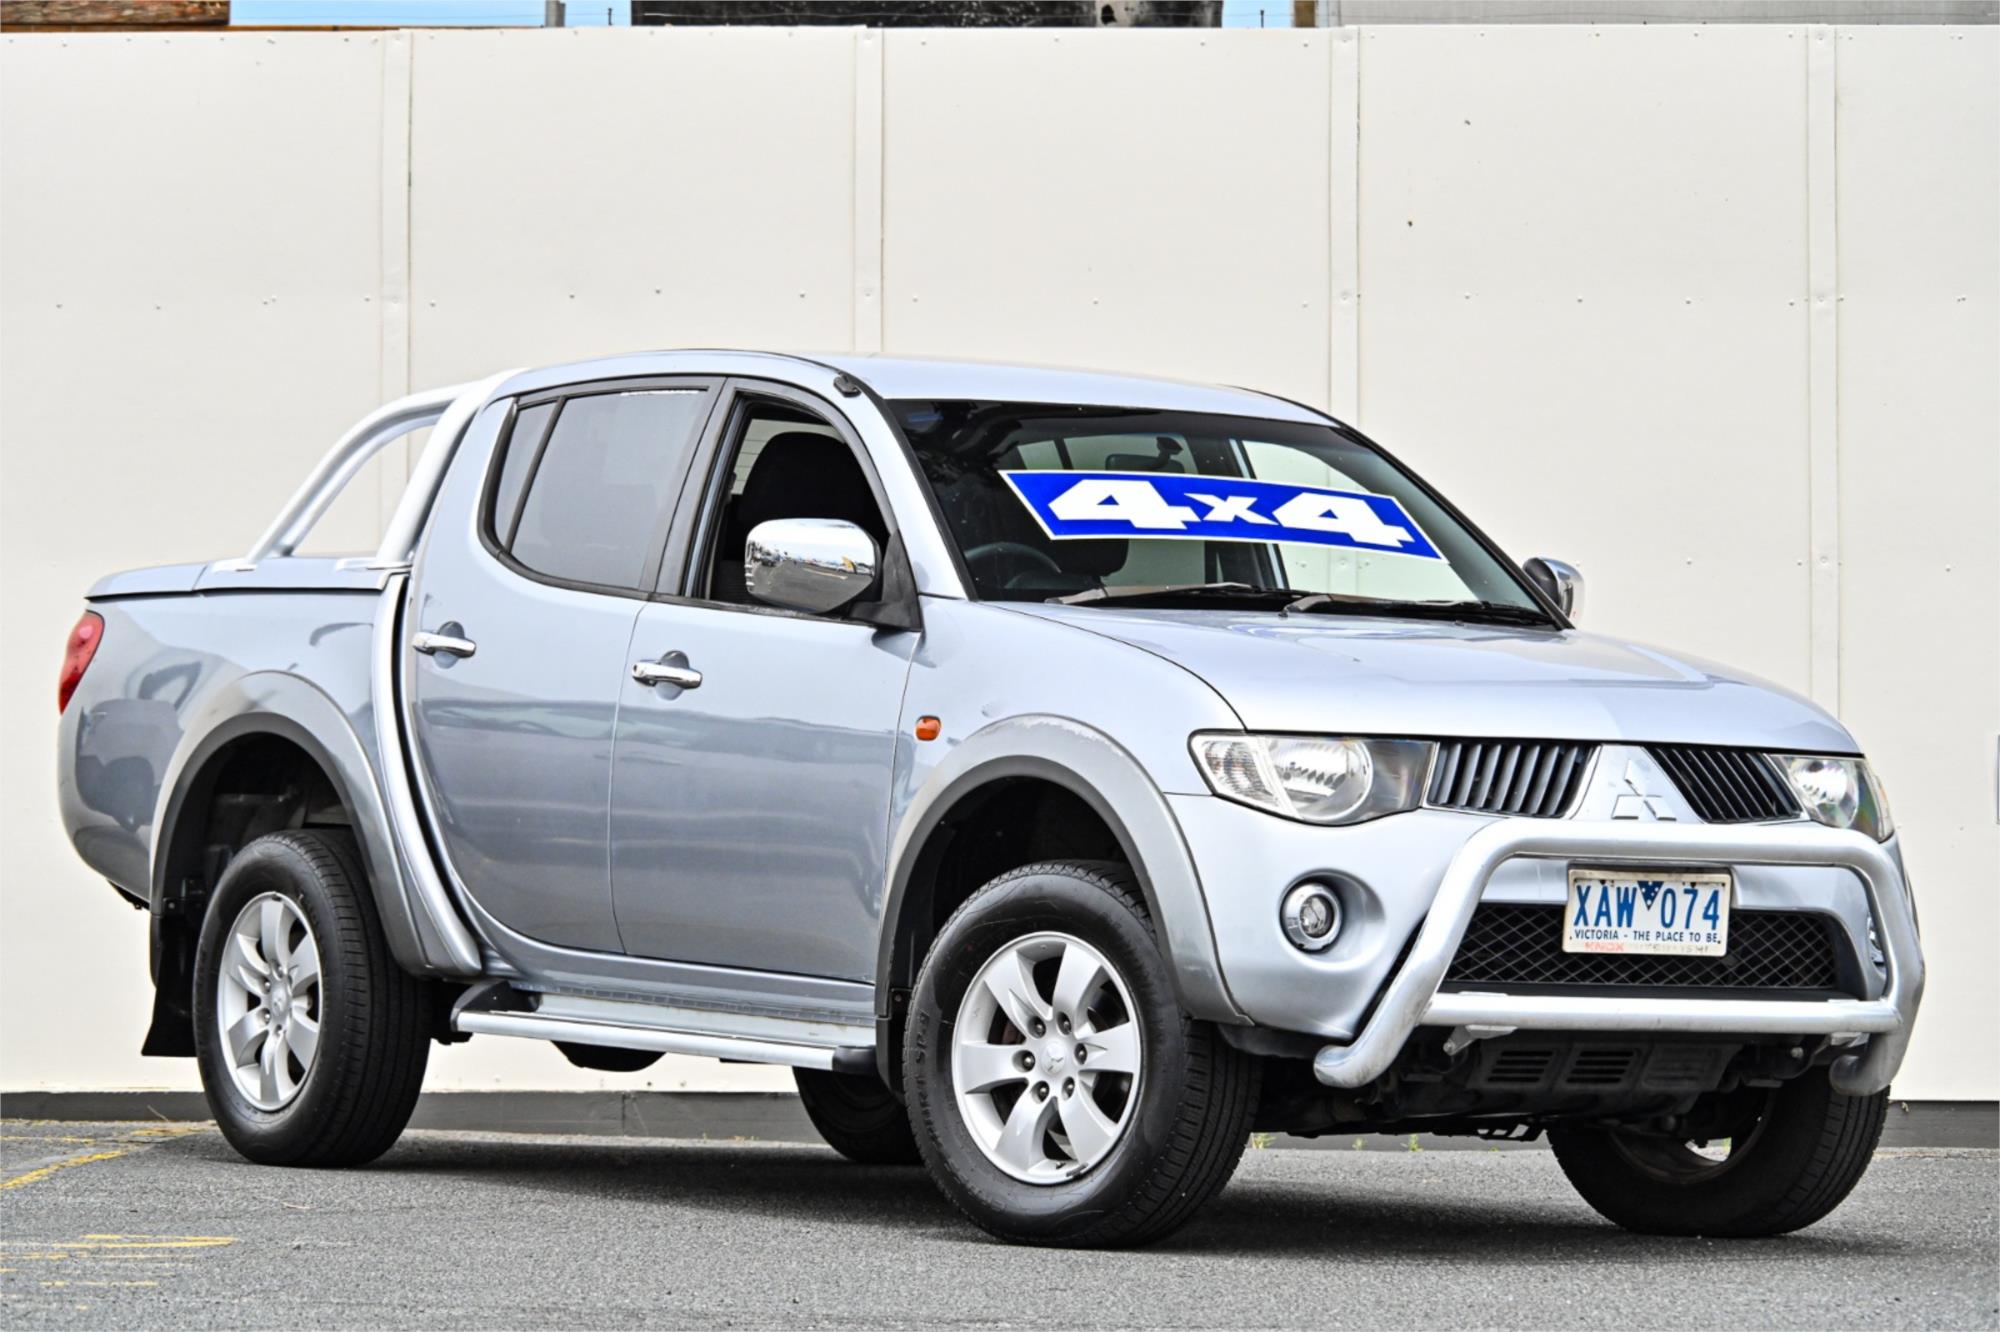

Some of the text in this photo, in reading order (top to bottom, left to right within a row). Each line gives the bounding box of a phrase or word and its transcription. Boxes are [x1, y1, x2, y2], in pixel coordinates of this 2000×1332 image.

[1574, 885, 1720, 930] XAW 074
[1574, 929, 1619, 940] VICTORIA
[1633, 930, 1650, 941] THE
[1655, 931, 1684, 943] PLACE
[1689, 932, 1701, 943] TO
